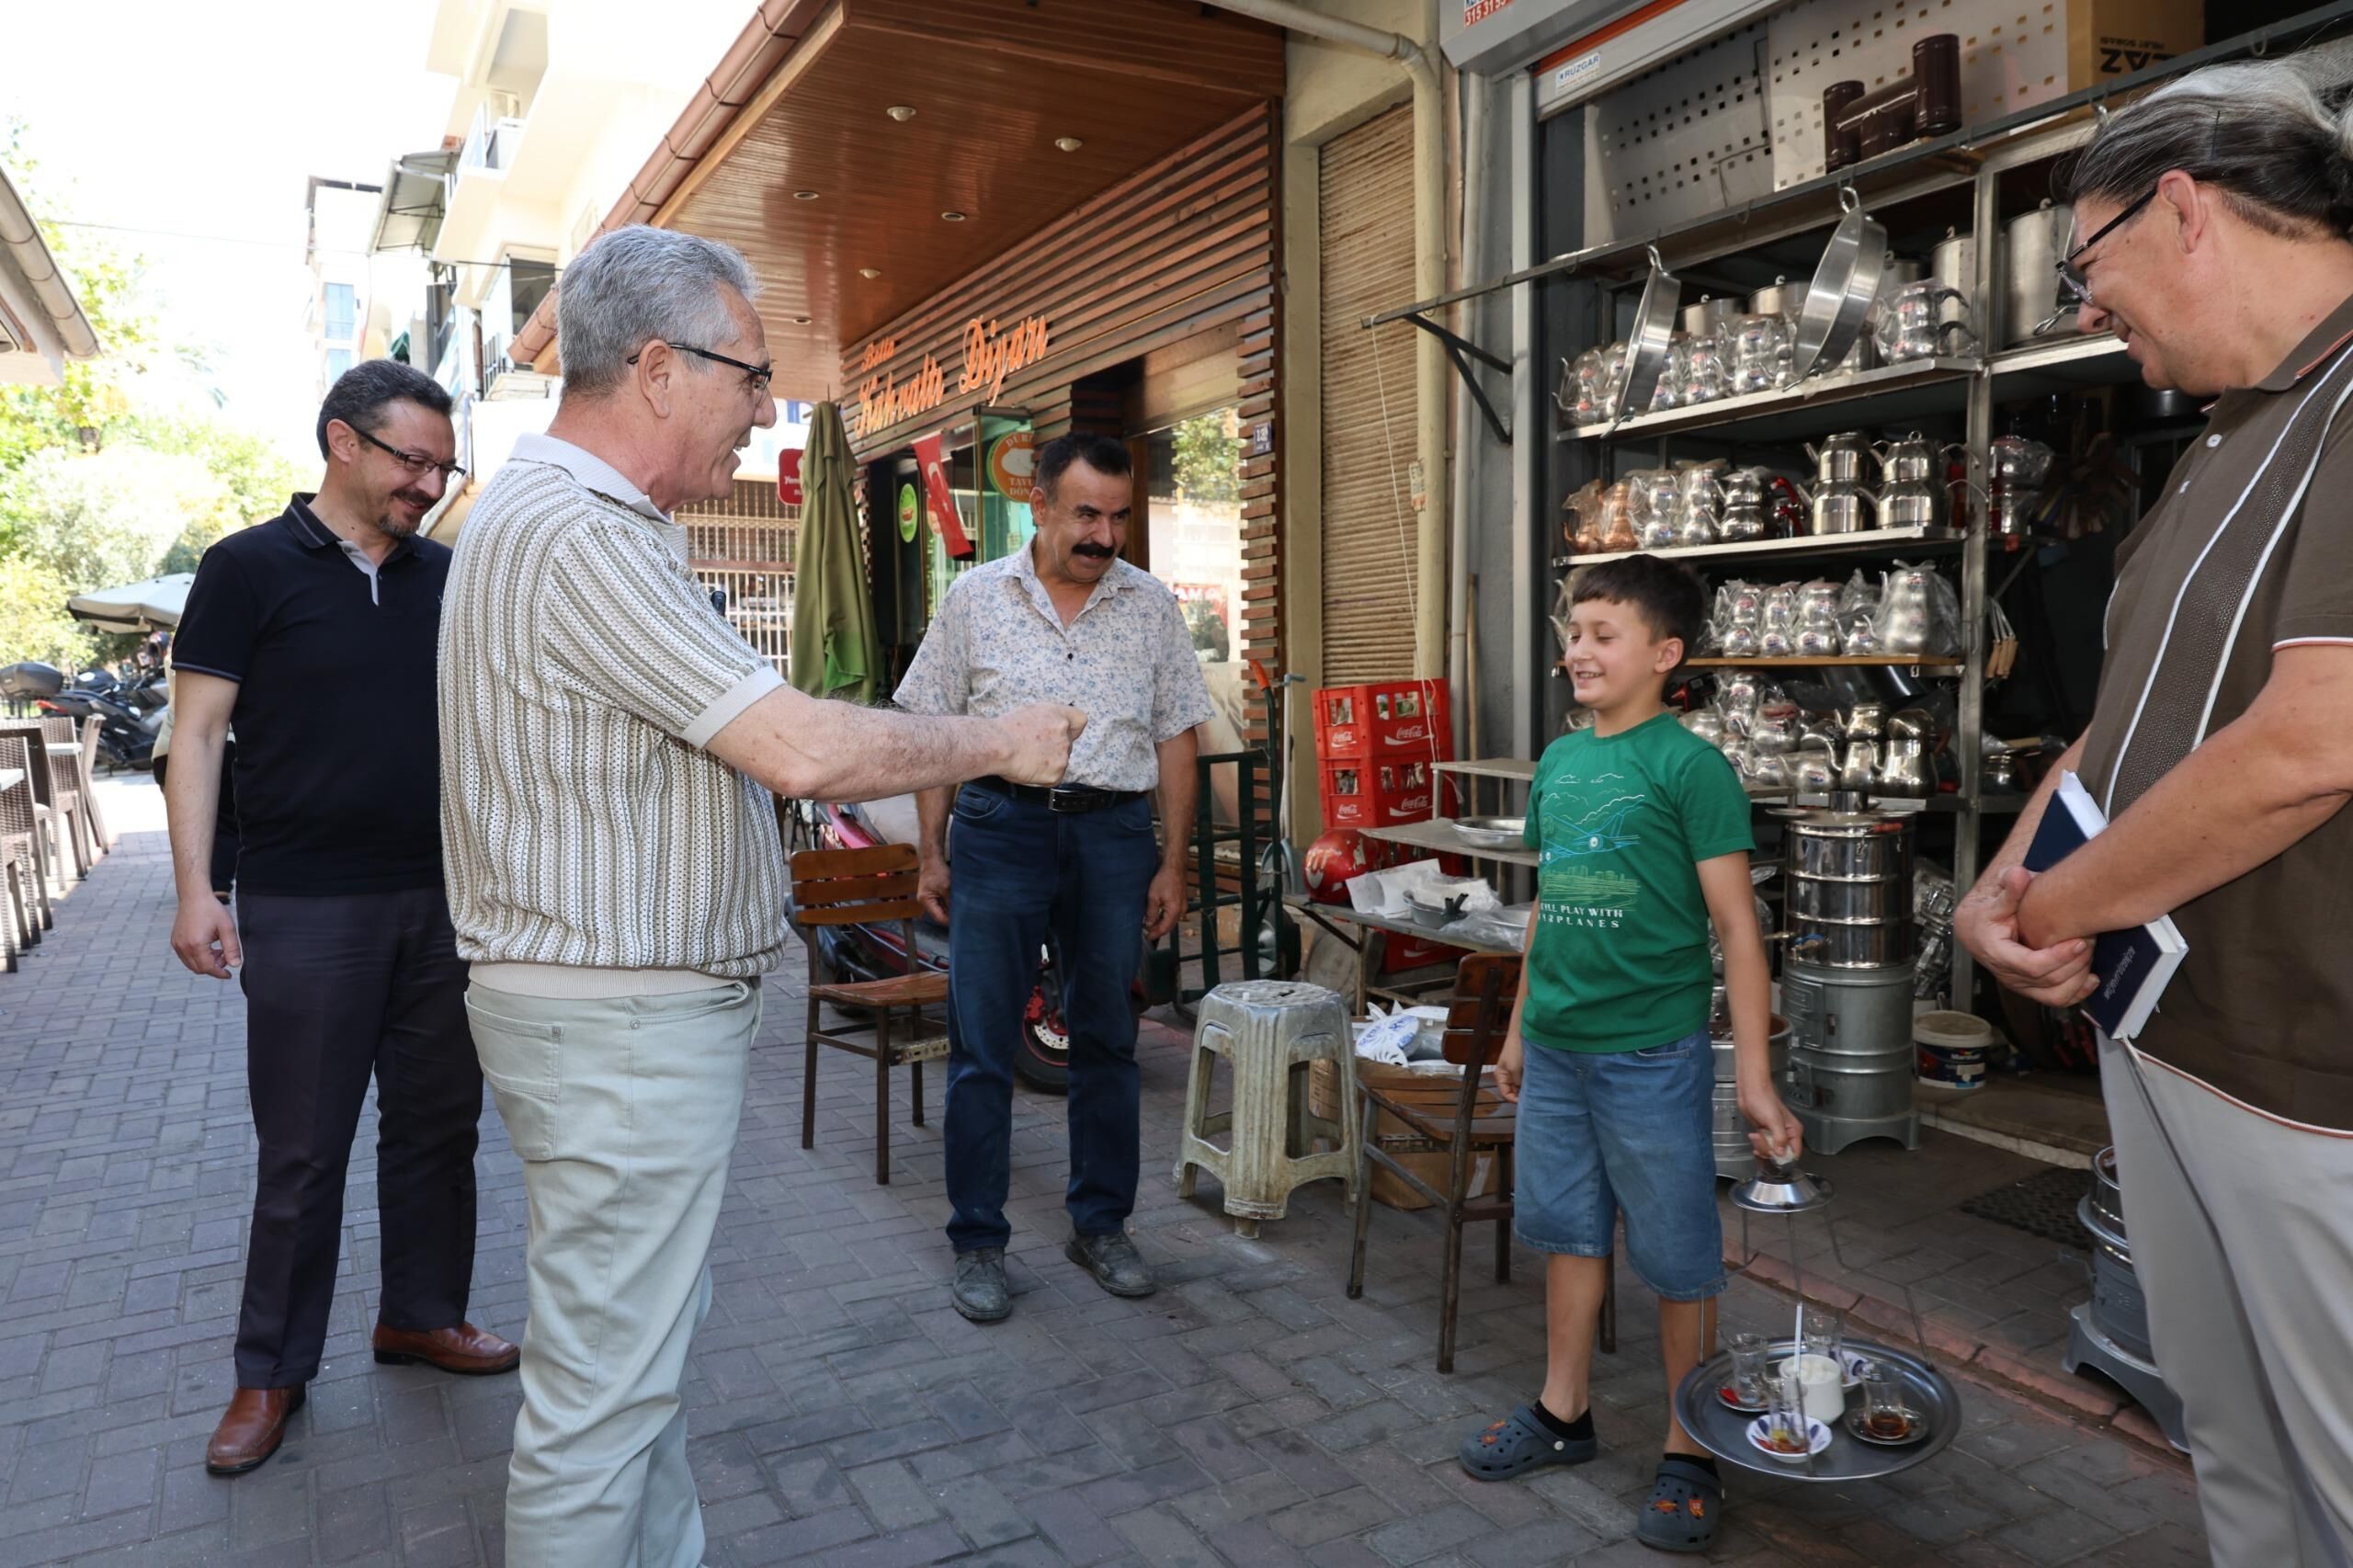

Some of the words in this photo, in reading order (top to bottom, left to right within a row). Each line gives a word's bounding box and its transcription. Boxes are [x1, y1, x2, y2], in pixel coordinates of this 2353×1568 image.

[1465, 5, 1482, 26] 315
[1540, 903, 1558, 913] TILL
[1560, 904, 1585, 915] PLAY
[1588, 907, 1623, 918] WITH
